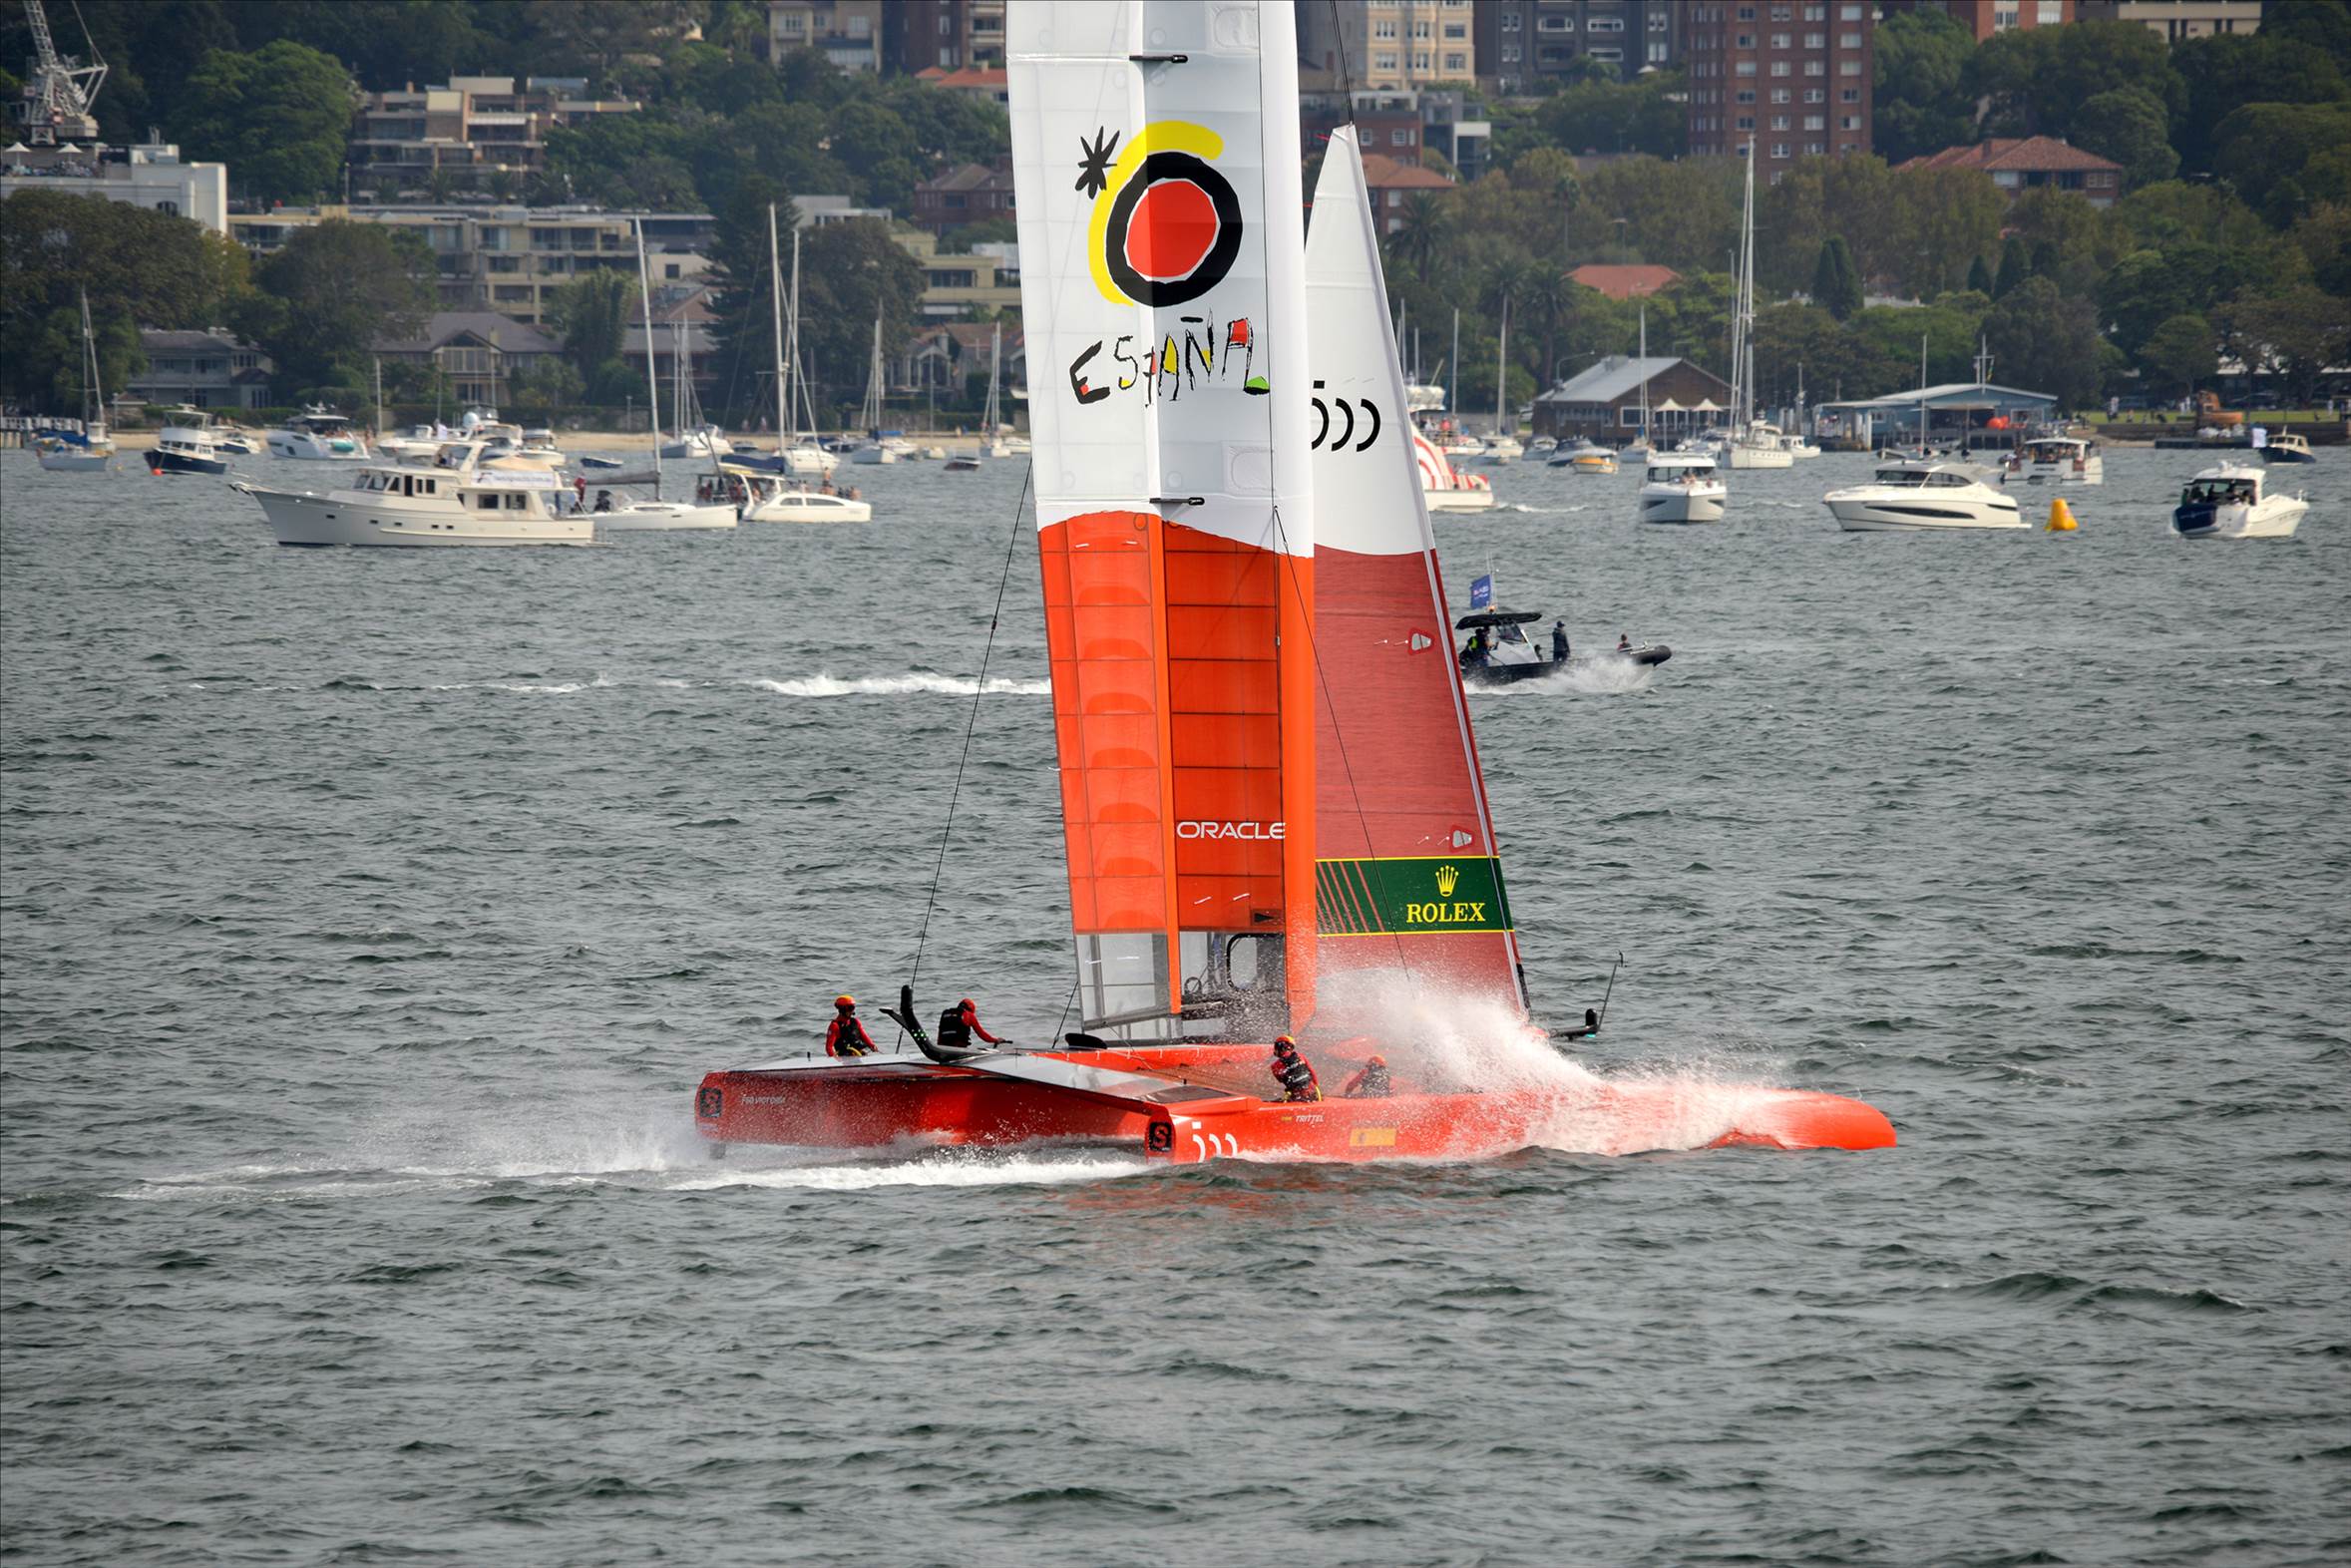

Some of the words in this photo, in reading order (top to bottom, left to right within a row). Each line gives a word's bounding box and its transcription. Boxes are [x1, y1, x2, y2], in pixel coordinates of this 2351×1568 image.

[1070, 309, 1270, 408] ESPAÑA
[1176, 821, 1286, 839] ORACLE
[1406, 903, 1486, 923] ROLEX
